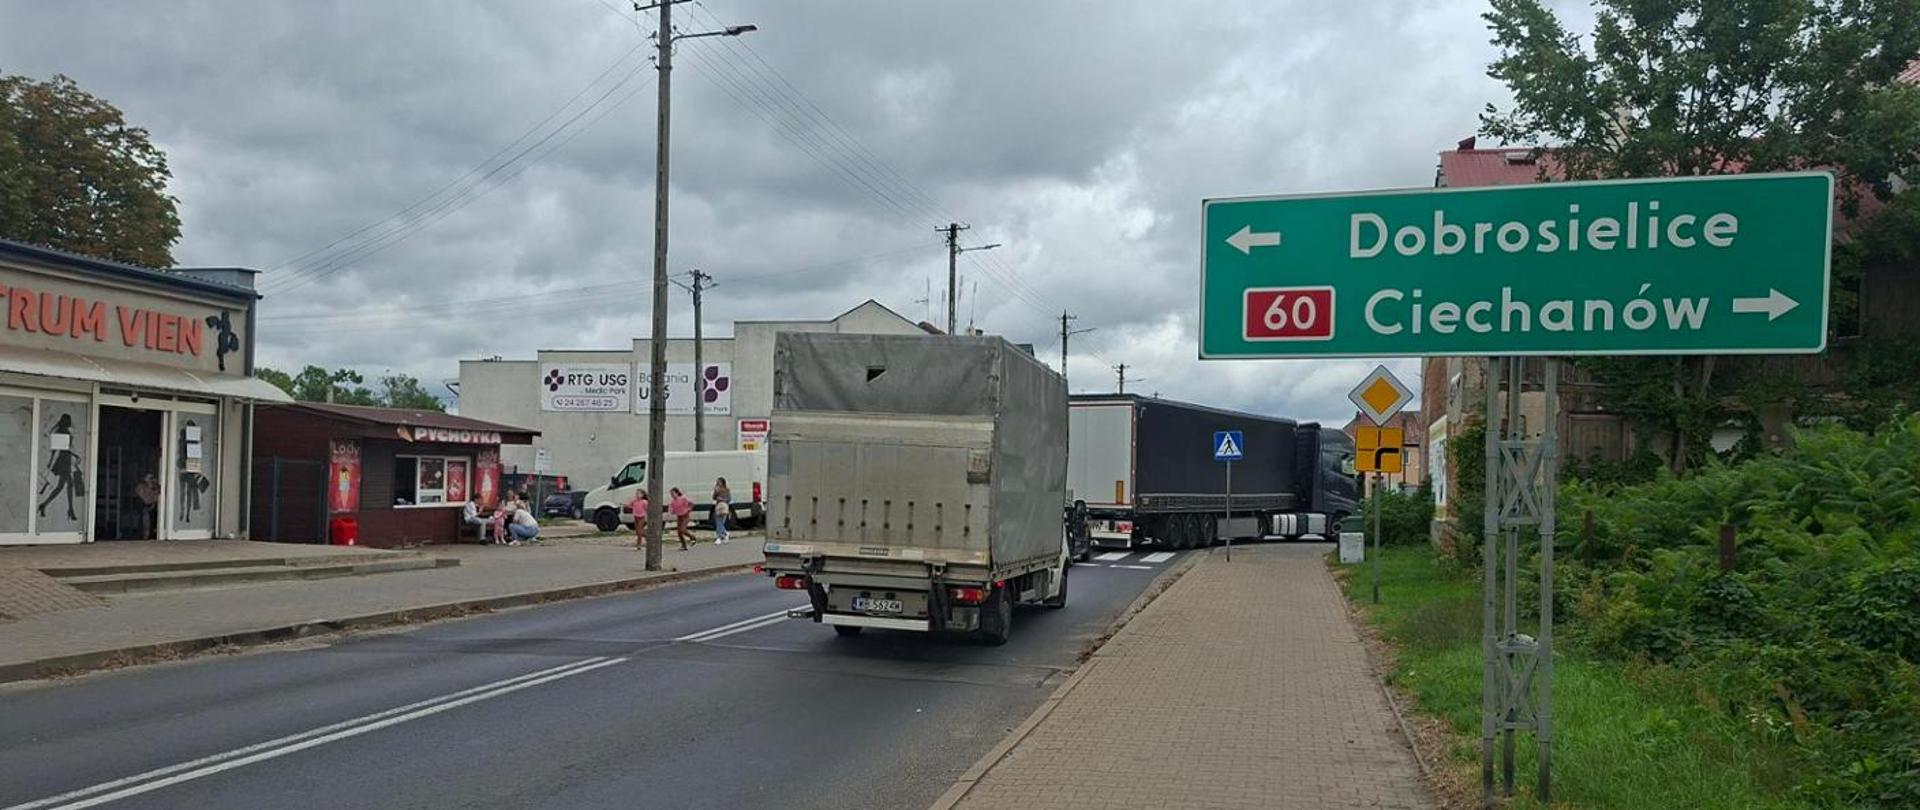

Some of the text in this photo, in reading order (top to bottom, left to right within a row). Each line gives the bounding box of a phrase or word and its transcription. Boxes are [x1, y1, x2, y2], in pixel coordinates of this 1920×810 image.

[1350, 200, 1739, 258] Dobrosielice
[116, 305, 205, 357] VIEN
[1264, 283, 1710, 334] 60 Ciechanów
[568, 373, 627, 386] RTG USG
[414, 427, 502, 444] PYCHOTKA
